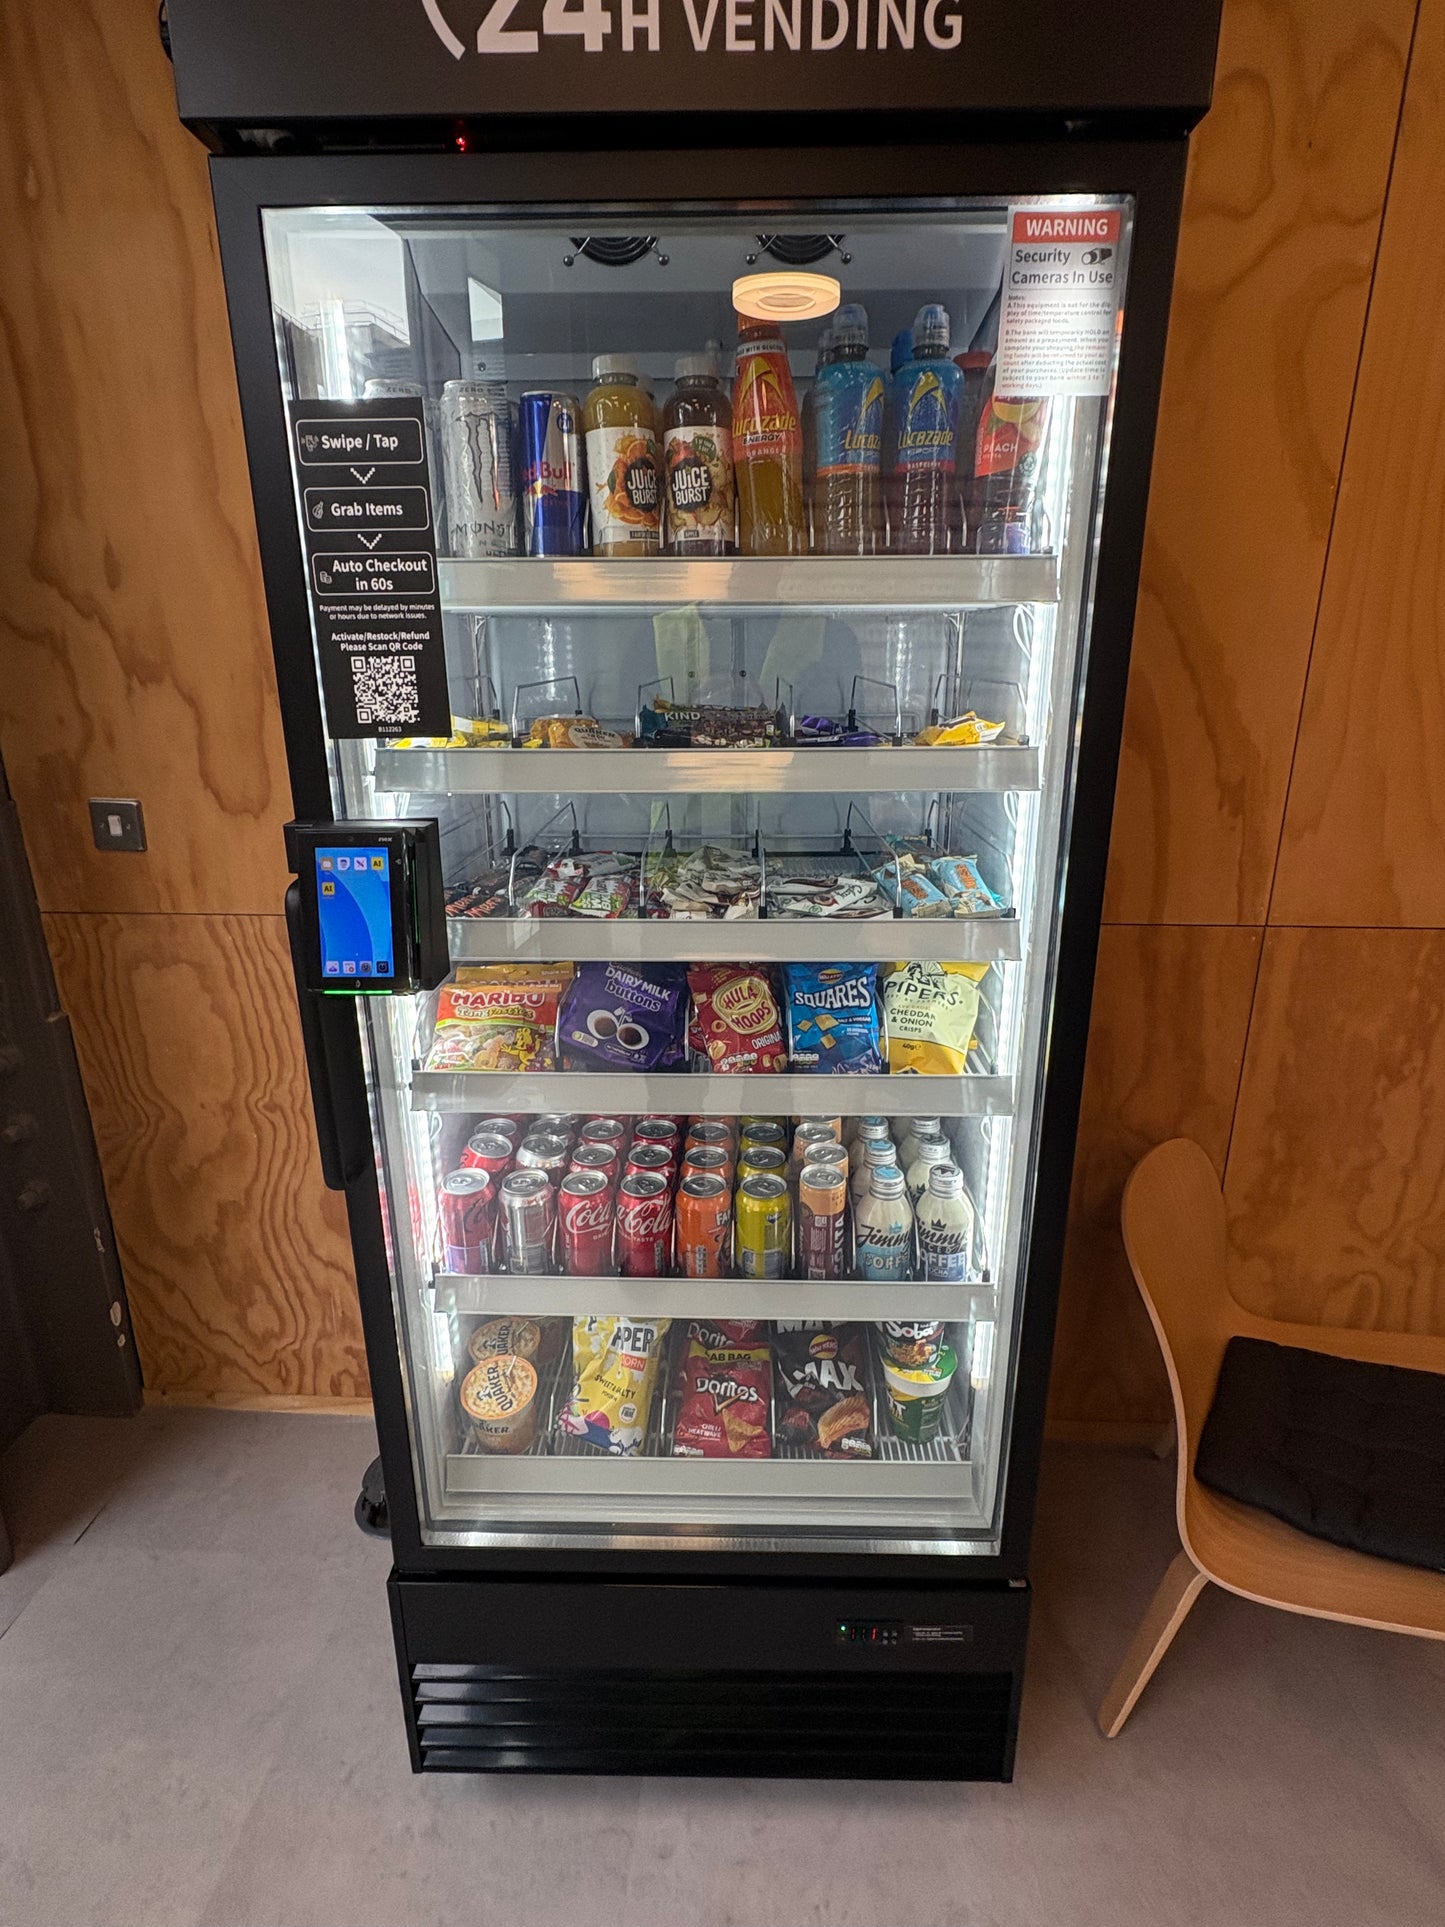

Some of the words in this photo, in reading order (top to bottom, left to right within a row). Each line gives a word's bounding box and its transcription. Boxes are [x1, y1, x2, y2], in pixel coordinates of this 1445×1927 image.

[685, 0, 962, 51] VENDING
[1026, 218, 1108, 236] WARNING
[1015, 248, 1071, 265] Security
[1012, 271, 1069, 284] Cameras
[1073, 271, 1085, 283] In
[1089, 270, 1113, 283] Use
[322, 434, 362, 451] Swipe
[366, 433, 371, 450] /
[373, 434, 398, 450] Tap
[743, 433, 782, 445] ENERGY
[898, 426, 954, 450] Lucozade
[541, 461, 572, 479] Bull
[672, 466, 709, 491] JUICE
[676, 487, 707, 506] BURST
[331, 502, 362, 517] Grab
[366, 502, 403, 516] Items
[332, 559, 363, 572] Auto
[366, 558, 428, 572] Checkout
[355, 578, 368, 590] in
[371, 578, 393, 590] 60s
[320, 604, 347, 612] Payment
[373, 604, 399, 612] delayed
[331, 631, 430, 641] Activate/Restock/Refund
[341, 643, 367, 651] Please
[368, 643, 388, 651] Scan
[389, 643, 401, 652] QR
[402, 642, 423, 650] Code
[665, 711, 700, 721] KIND
[605, 966, 643, 988] DAIRY
[641, 981, 671, 1001] MILK
[795, 977, 871, 1008] SQUARES
[451, 990, 545, 1008] HARIBO
[605, 979, 661, 1012] buttons
[723, 985, 758, 1010] HULA
[885, 981, 959, 1005] PIPERS
[731, 1001, 771, 1029] HOOPS
[900, 1017, 933, 1027] ONION
[728, 1353, 751, 1361] BAG
[487, 1365, 515, 1411] QUAKER
[696, 1378, 758, 1401] Doritos
